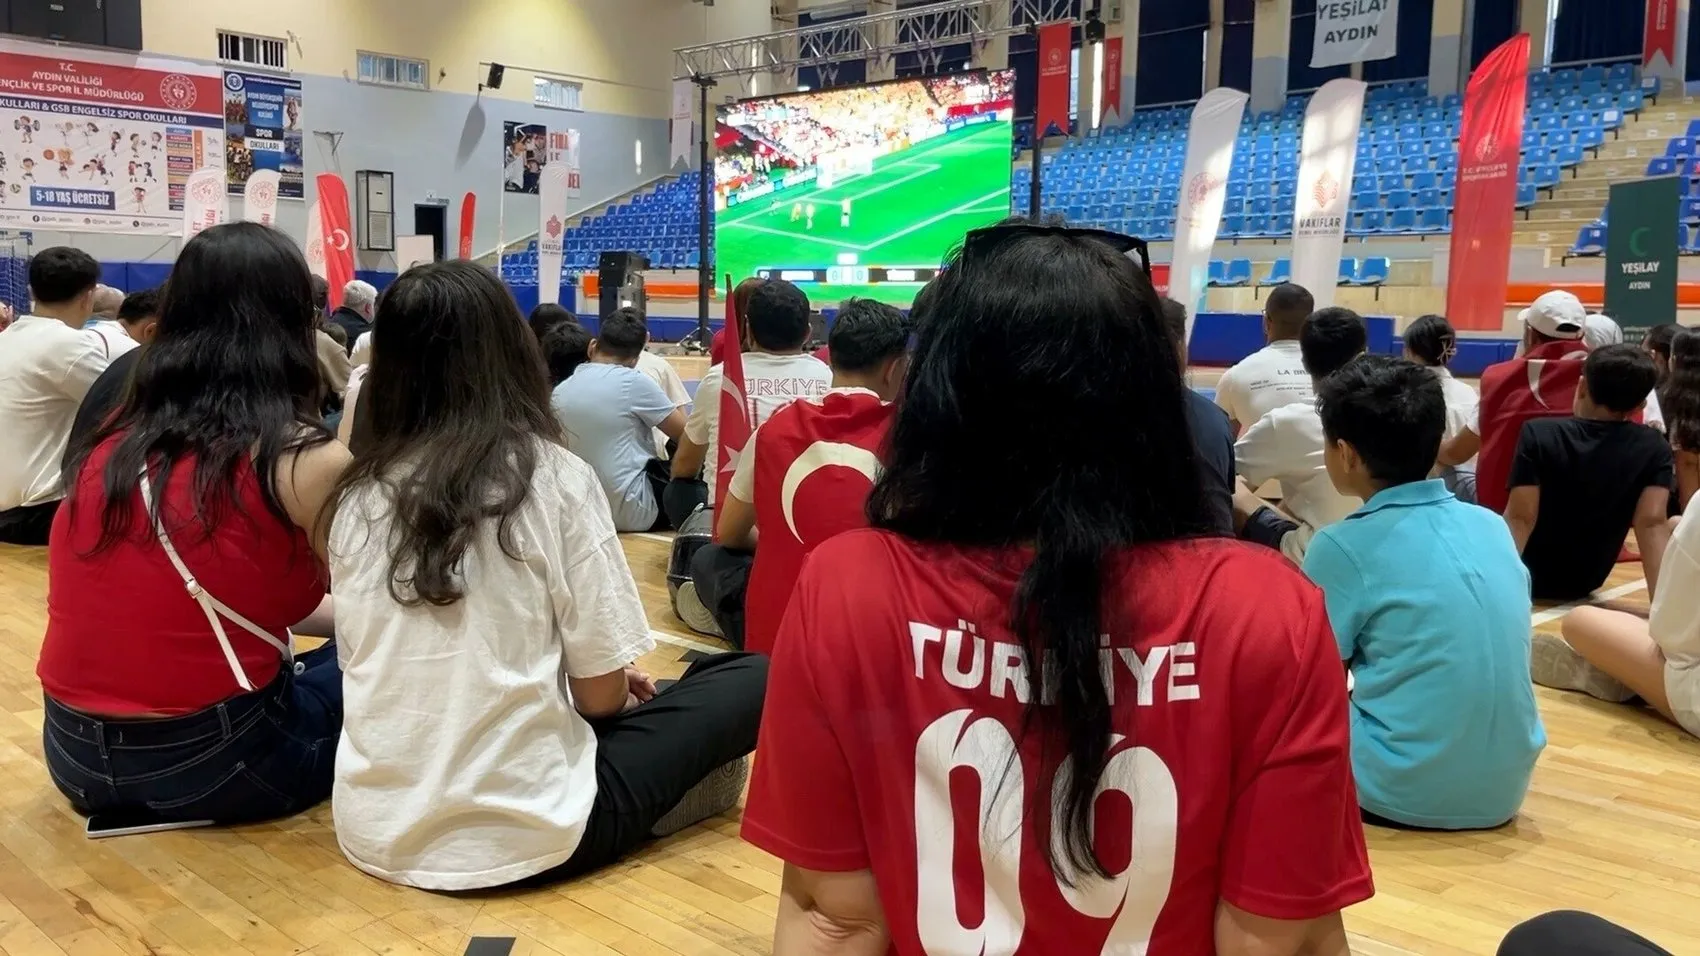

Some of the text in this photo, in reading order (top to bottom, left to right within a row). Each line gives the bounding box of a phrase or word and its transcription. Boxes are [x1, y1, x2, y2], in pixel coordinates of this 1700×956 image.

[1318, 0, 1387, 20] YEŞİLAY
[1324, 24, 1378, 44] AYDIN
[59, 62, 76, 73] T.C.
[32, 71, 62, 82] AYDIN
[32, 82, 45, 91] VE
[46, 83, 72, 94] SPOR
[41, 102, 50, 111] &
[51, 103, 70, 113] GSB
[71, 105, 116, 118] ENGELSİZ
[117, 109, 142, 120] SPOR
[143, 112, 187, 124] OKULLARI
[255, 128, 273, 138] SPOR
[250, 140, 280, 150] OKULLARI
[36, 190, 110, 206] 5-18 YAŞ ÜCRETSİZ
[1299, 217, 1341, 228] VAKIFLAR
[1621, 261, 1660, 276] YEŞİLAY
[1628, 281, 1651, 290] AYDIN
[745, 377, 828, 396] ÜRKİYE
[914, 708, 1178, 956] 09
